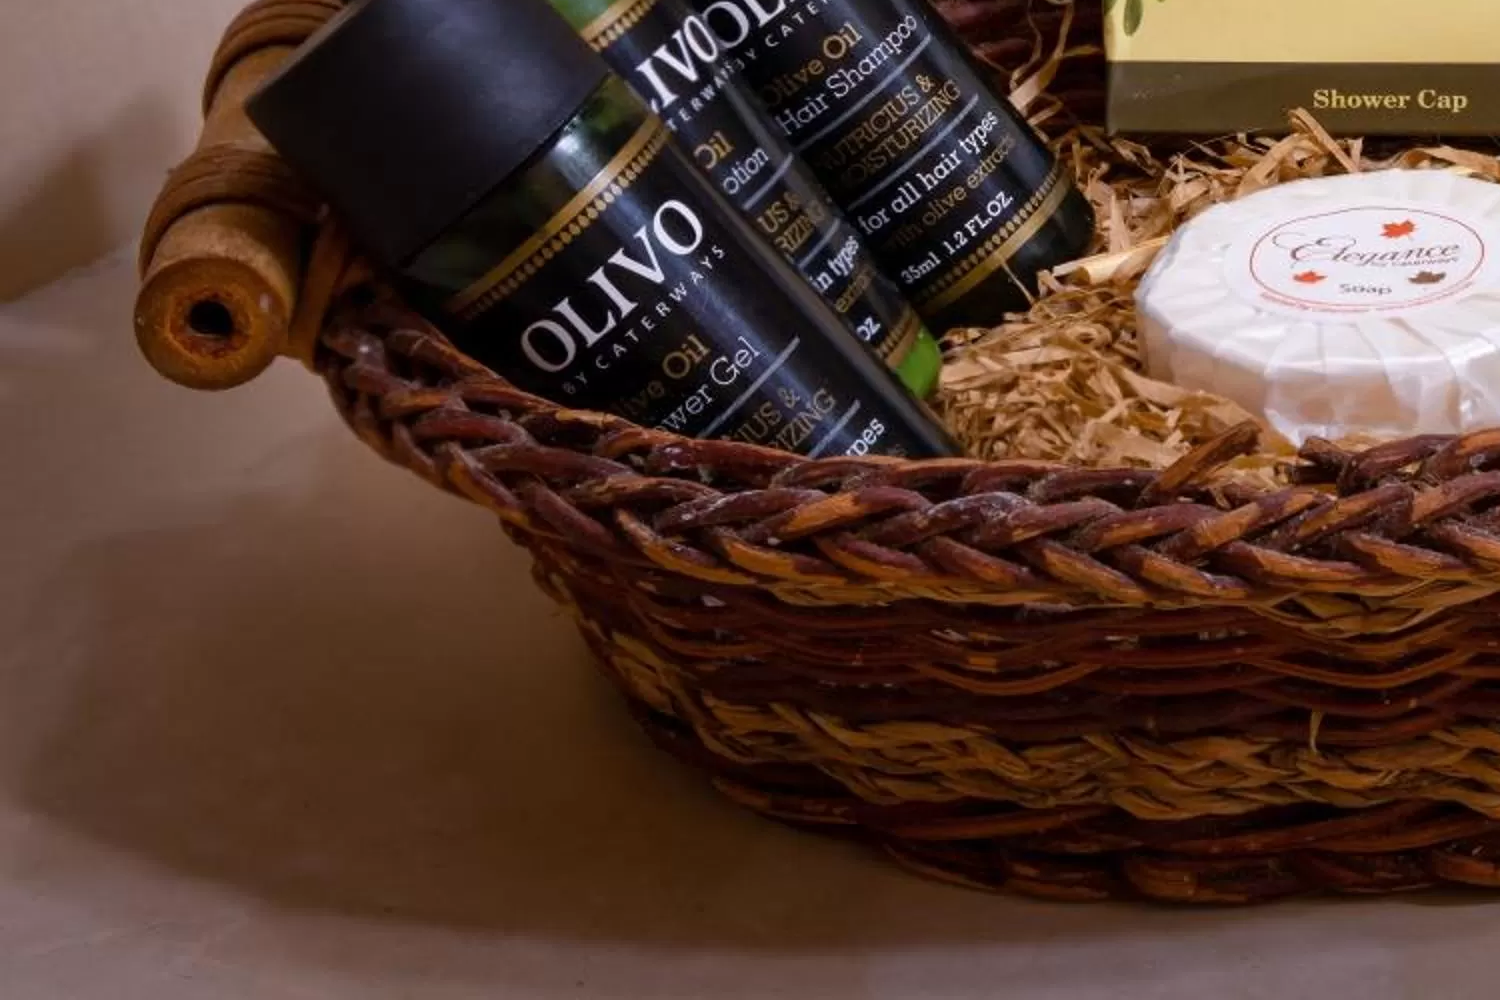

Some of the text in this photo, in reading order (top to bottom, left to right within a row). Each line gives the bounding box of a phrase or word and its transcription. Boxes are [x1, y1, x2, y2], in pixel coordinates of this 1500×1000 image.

[635, 14, 719, 113] IVO
[763, 21, 863, 104] Olive Oil
[775, 14, 918, 136] Hair Shampoo
[915, 72, 937, 93] &
[1313, 88, 1468, 112] Shower Cap
[720, 147, 769, 196] otion
[857, 110, 1000, 236] for all hair types
[921, 183, 968, 227] olive
[900, 251, 942, 286] 35ml
[941, 232, 969, 256] 1.2
[1273, 232, 1460, 267] Elegance
[519, 199, 704, 374] OLIVO
[1339, 283, 1392, 295] Soap
[561, 245, 727, 396] BY CATERWAYS
[661, 333, 712, 380] Oil
[656, 383, 714, 433] wer
[709, 336, 761, 386] Gel
